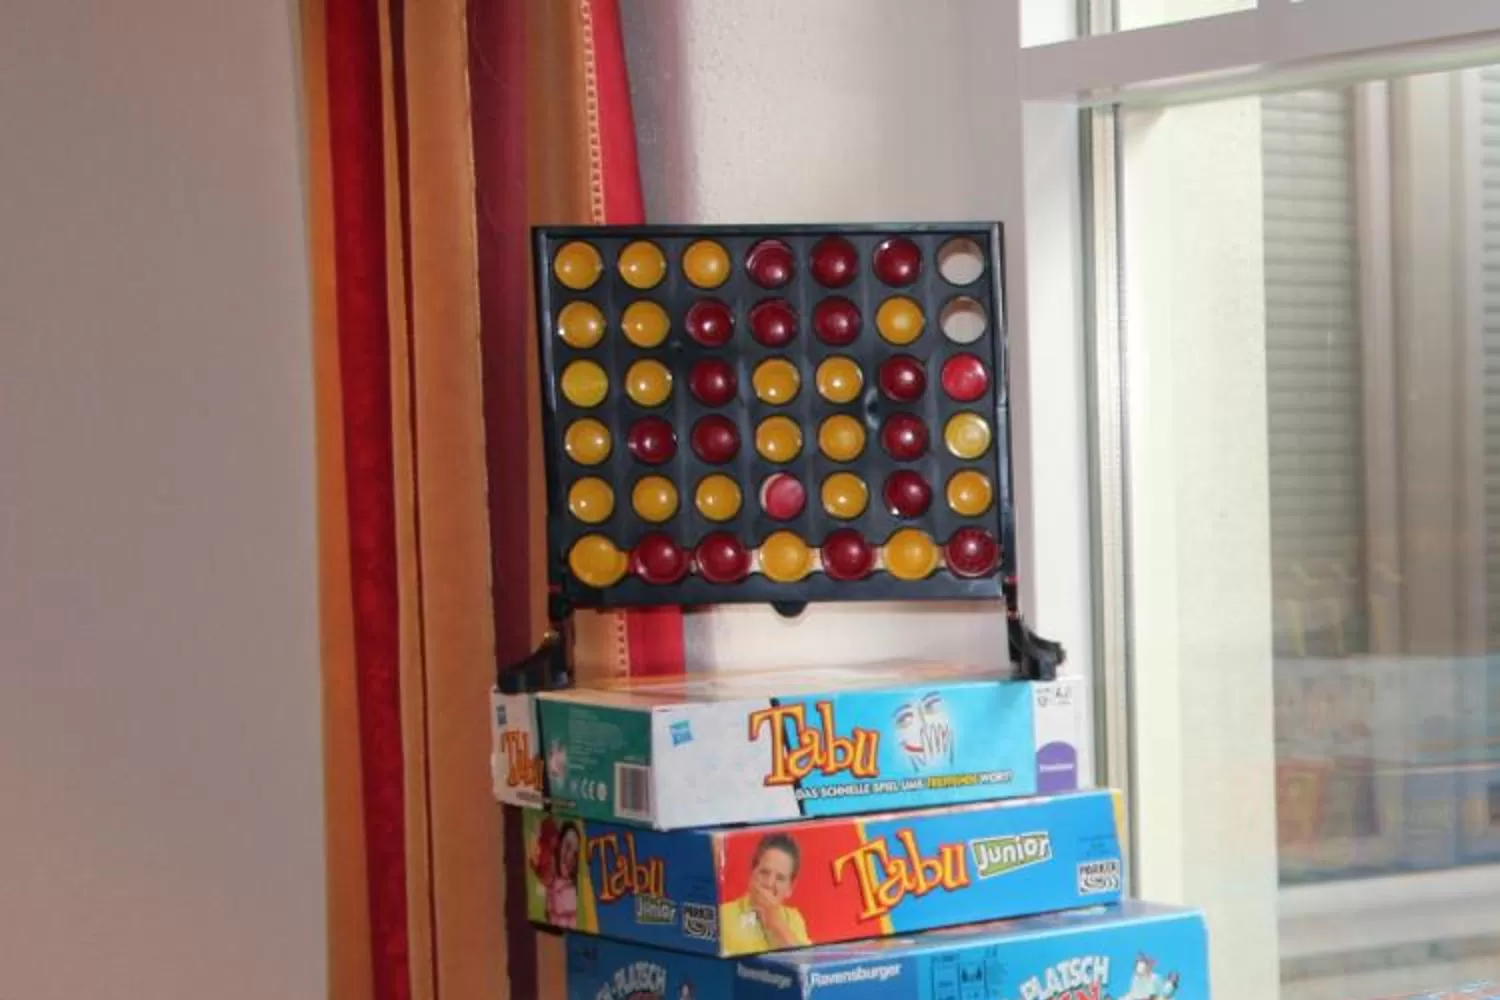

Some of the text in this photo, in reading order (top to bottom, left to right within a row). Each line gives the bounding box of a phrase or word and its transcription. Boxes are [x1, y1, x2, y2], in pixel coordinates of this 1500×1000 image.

[749, 701, 882, 787] Tabu
[587, 832, 667, 902] Tabu
[834, 827, 1053, 922] Tabu Junior
[810, 962, 902, 989] Ravensburger
